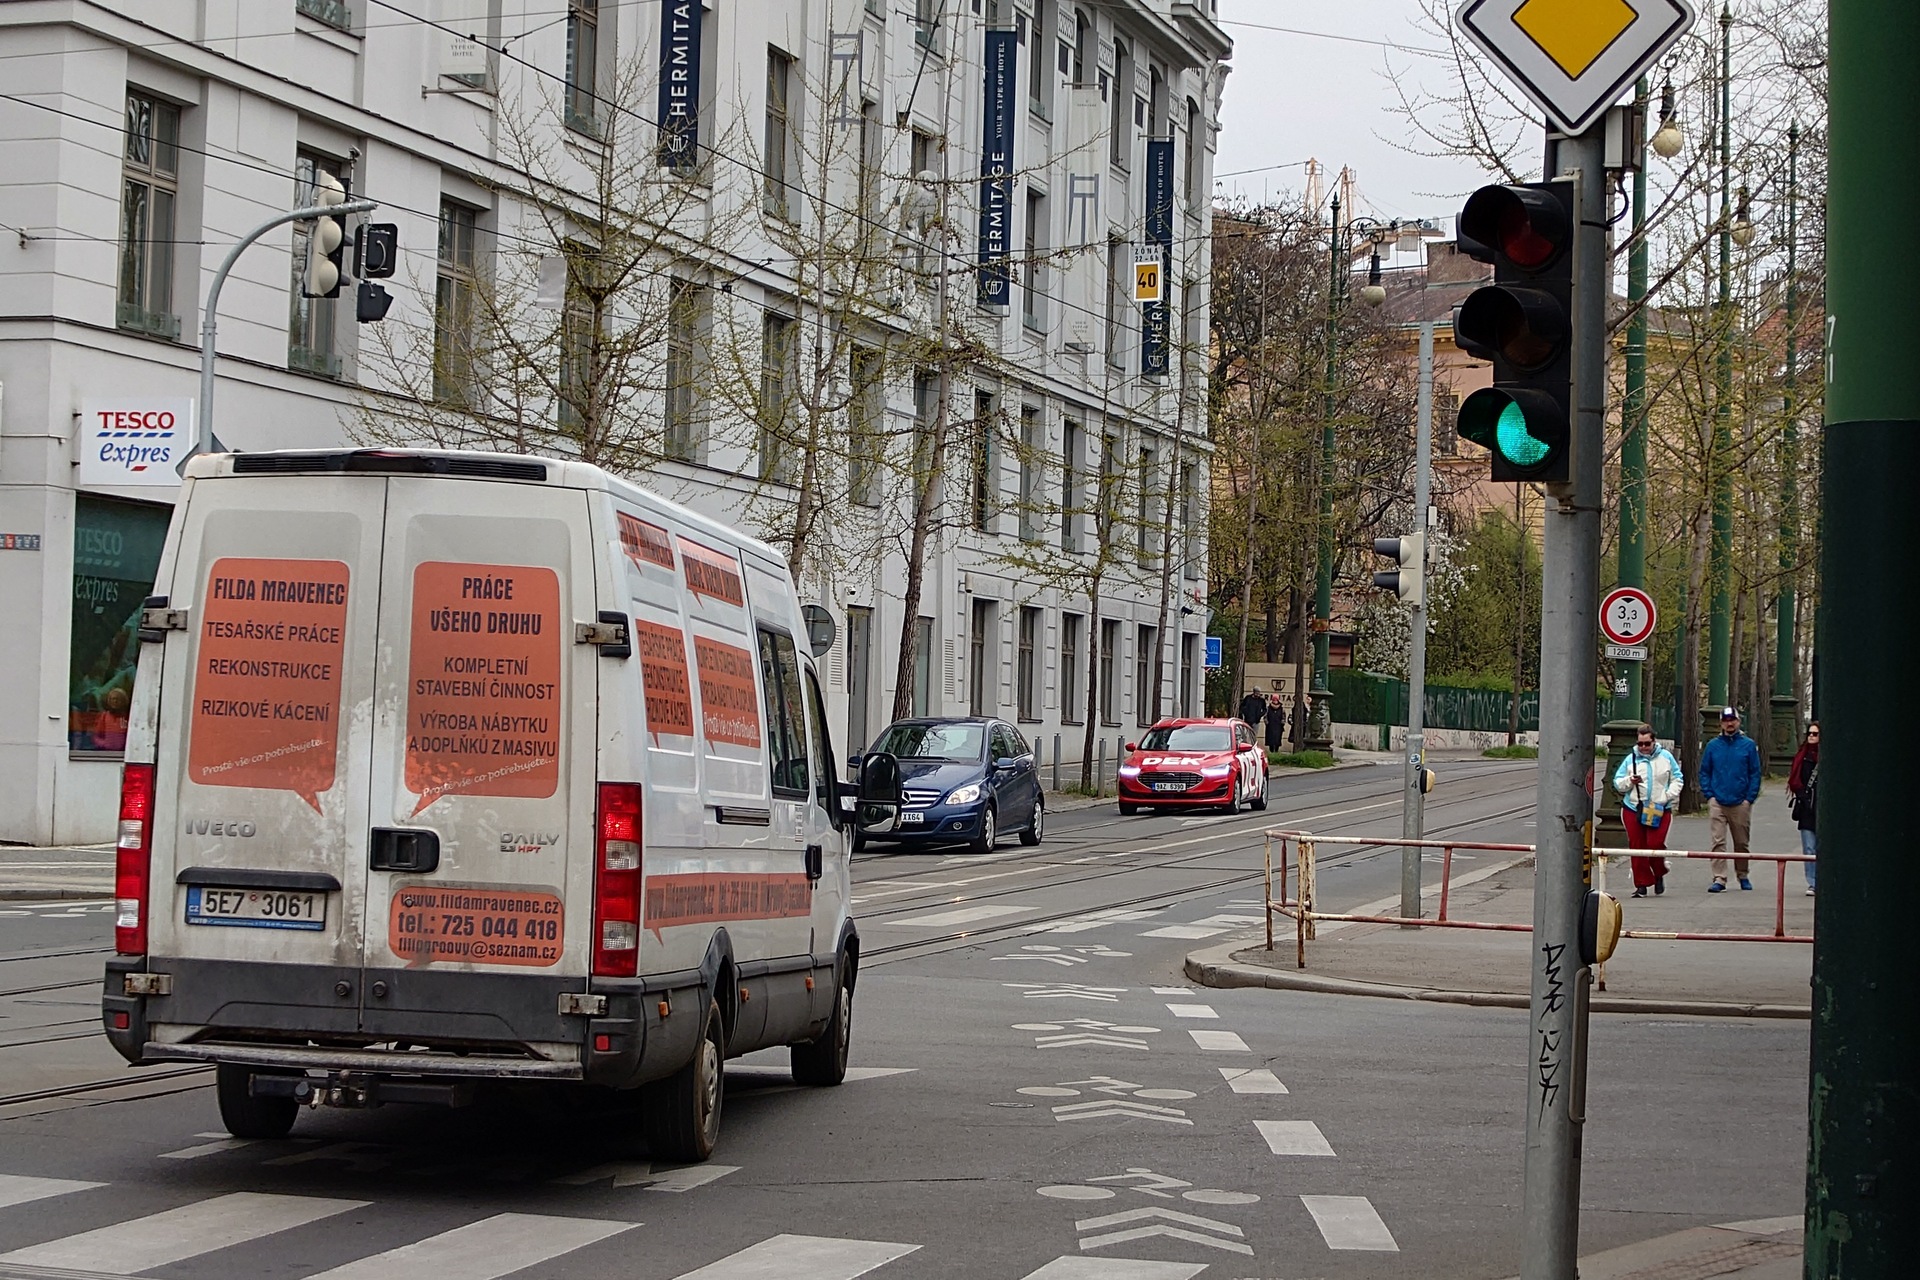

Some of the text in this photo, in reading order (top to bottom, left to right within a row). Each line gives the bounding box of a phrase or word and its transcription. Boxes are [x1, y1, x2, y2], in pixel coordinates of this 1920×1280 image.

[670, 0, 691, 116] HERMITA
[997, 41, 1005, 71] HOTEL
[989, 152, 1005, 277] HERMITAGE
[1138, 272, 1156, 288] 40
[97, 412, 175, 429] TESCO
[100, 442, 170, 468] expres
[76, 527, 122, 555] TESCO
[75, 575, 119, 609] expres
[214, 578, 345, 605] FILDA MRAVENEC
[462, 574, 513, 600] PRÁCE
[430, 606, 542, 635] VŠEHO DRUHU
[1617, 605, 1638, 620] 3,3
[206, 620, 340, 644] TESAŘSKÉ PRÁCE
[1613, 648, 1630, 657] 1200
[209, 658, 331, 680] REKONSTRUKCE
[444, 656, 529, 675] KOMPLETNÍ
[416, 677, 554, 700] STAVEBNÍ ČINNOST
[201, 699, 330, 722] RIZIKOVÉ KÁCENÍ
[420, 710, 548, 733] VÝROBA NÁBYTKU
[408, 733, 556, 757] A DOPLŇKŮ Z MASIVU
[251, 754, 264, 763] co
[1141, 757, 1203, 766] DEK
[474, 774, 486, 783] co
[185, 819, 257, 838] IVECO
[518, 845, 541, 853] HPT
[188, 890, 314, 918] CZ 5E7 3061
[400, 893, 559, 914] www.fildamravenec.cz
[398, 911, 557, 940] tel.: 725 044 418
[398, 937, 557, 960] filipgroovy@seznam.cz
